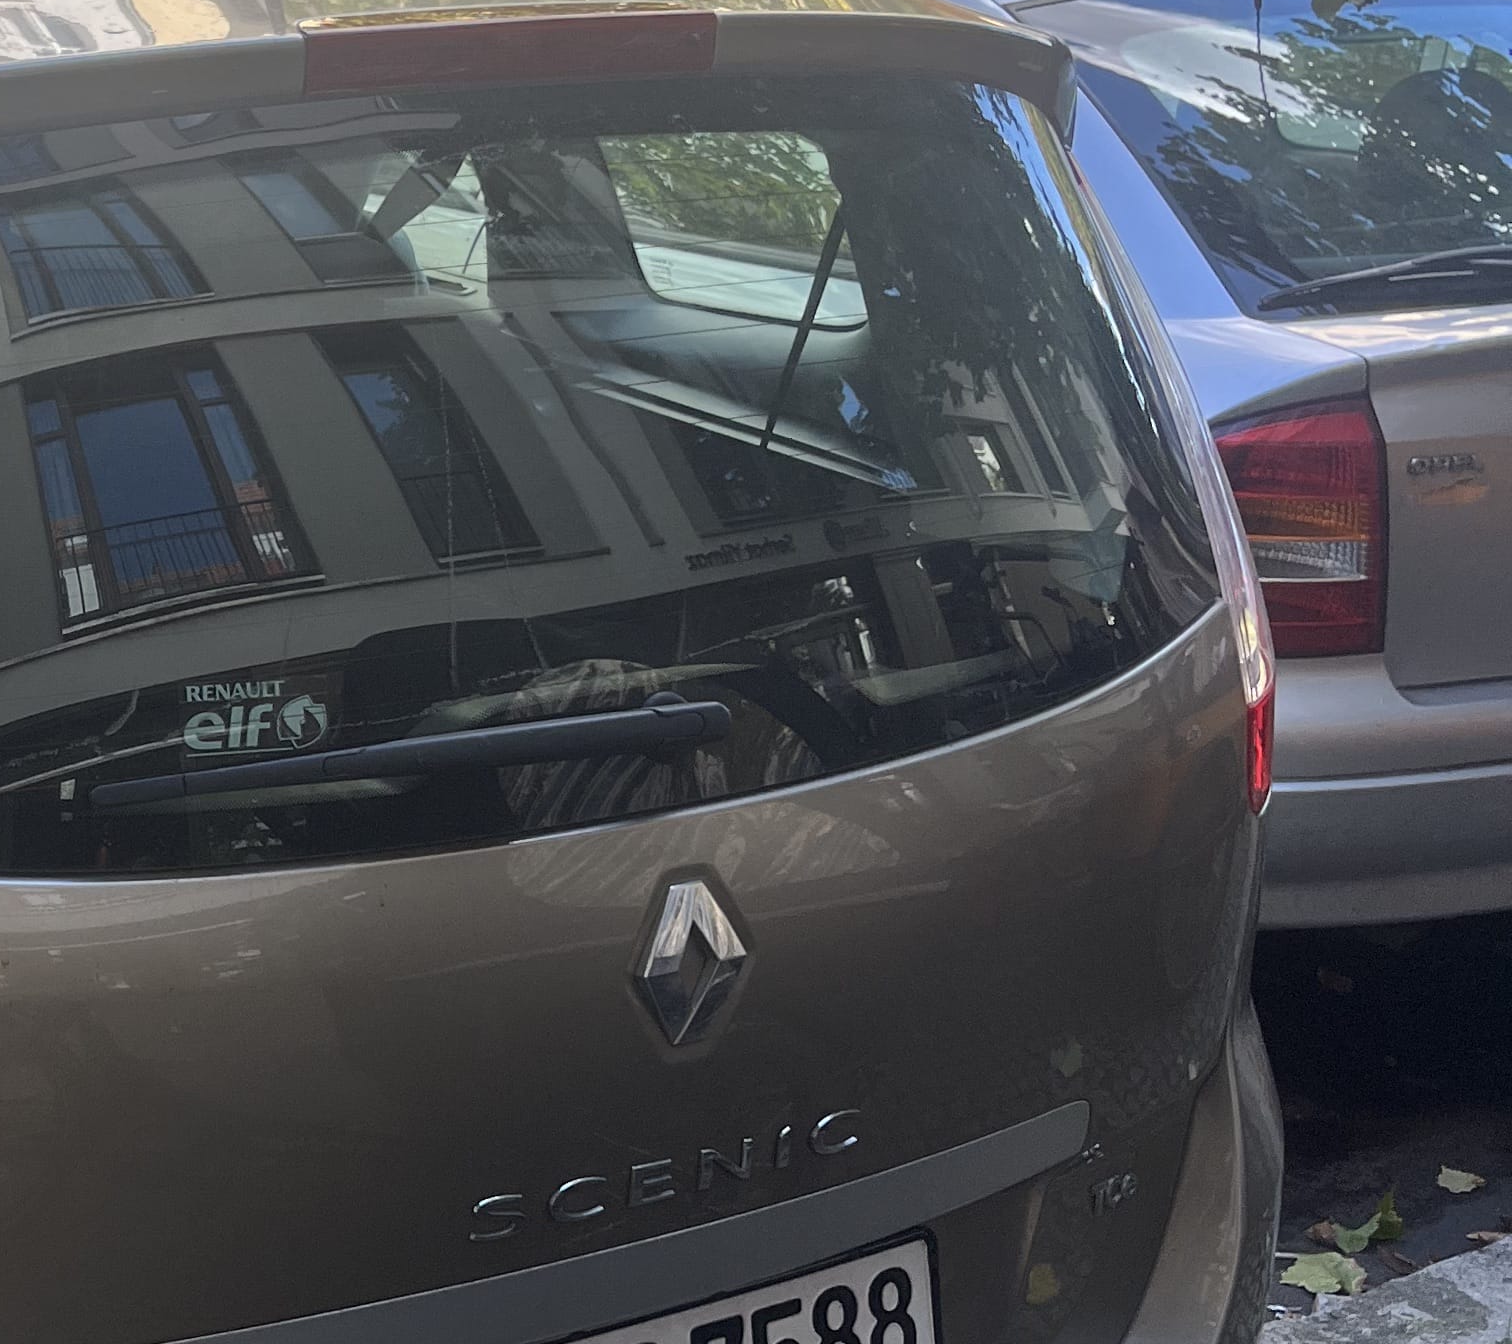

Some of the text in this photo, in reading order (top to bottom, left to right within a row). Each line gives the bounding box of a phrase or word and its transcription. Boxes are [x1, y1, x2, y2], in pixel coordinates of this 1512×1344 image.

[185, 680, 285, 703] RENAULT
[183, 703, 273, 751] elf
[468, 1108, 862, 1241] SCENIC
